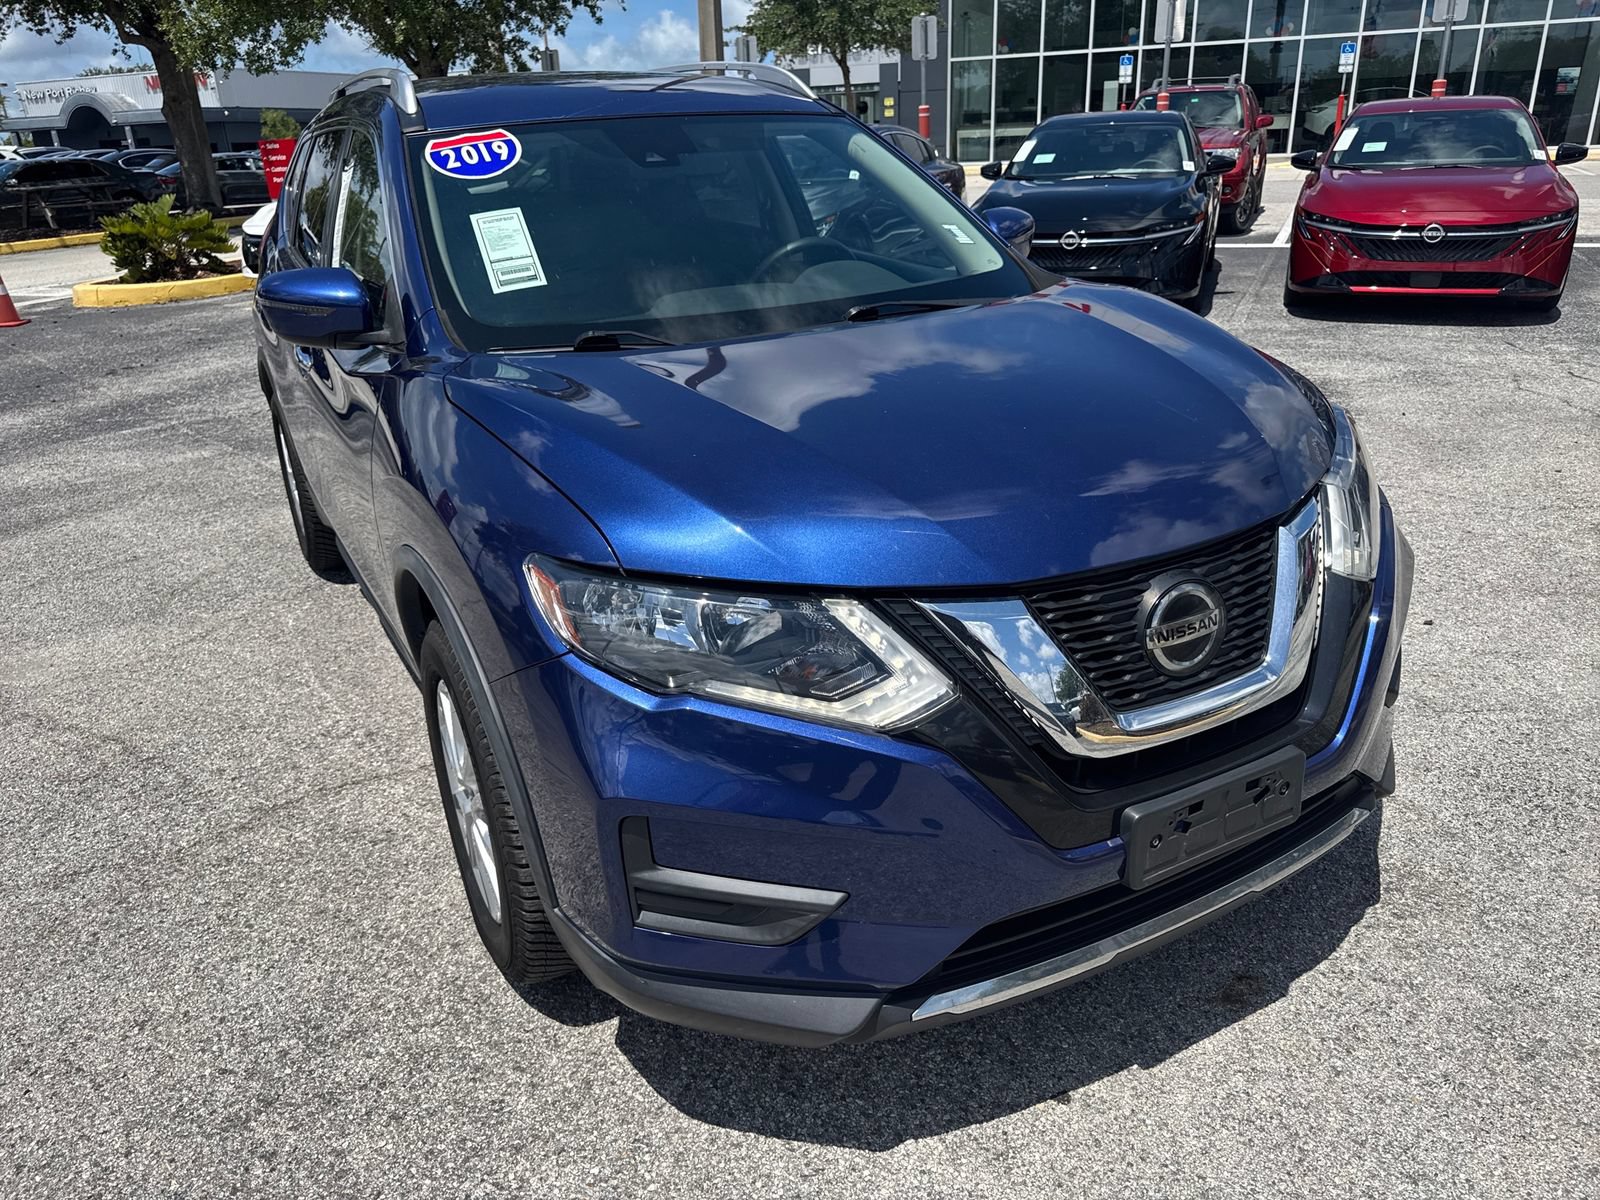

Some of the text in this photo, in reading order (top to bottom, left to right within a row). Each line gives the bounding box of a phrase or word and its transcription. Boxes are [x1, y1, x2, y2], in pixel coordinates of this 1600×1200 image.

[24, 89, 45, 100] New
[46, 88, 65, 99] Port
[440, 140, 509, 169] 2019
[1156, 613, 1218, 643] NISSAN
